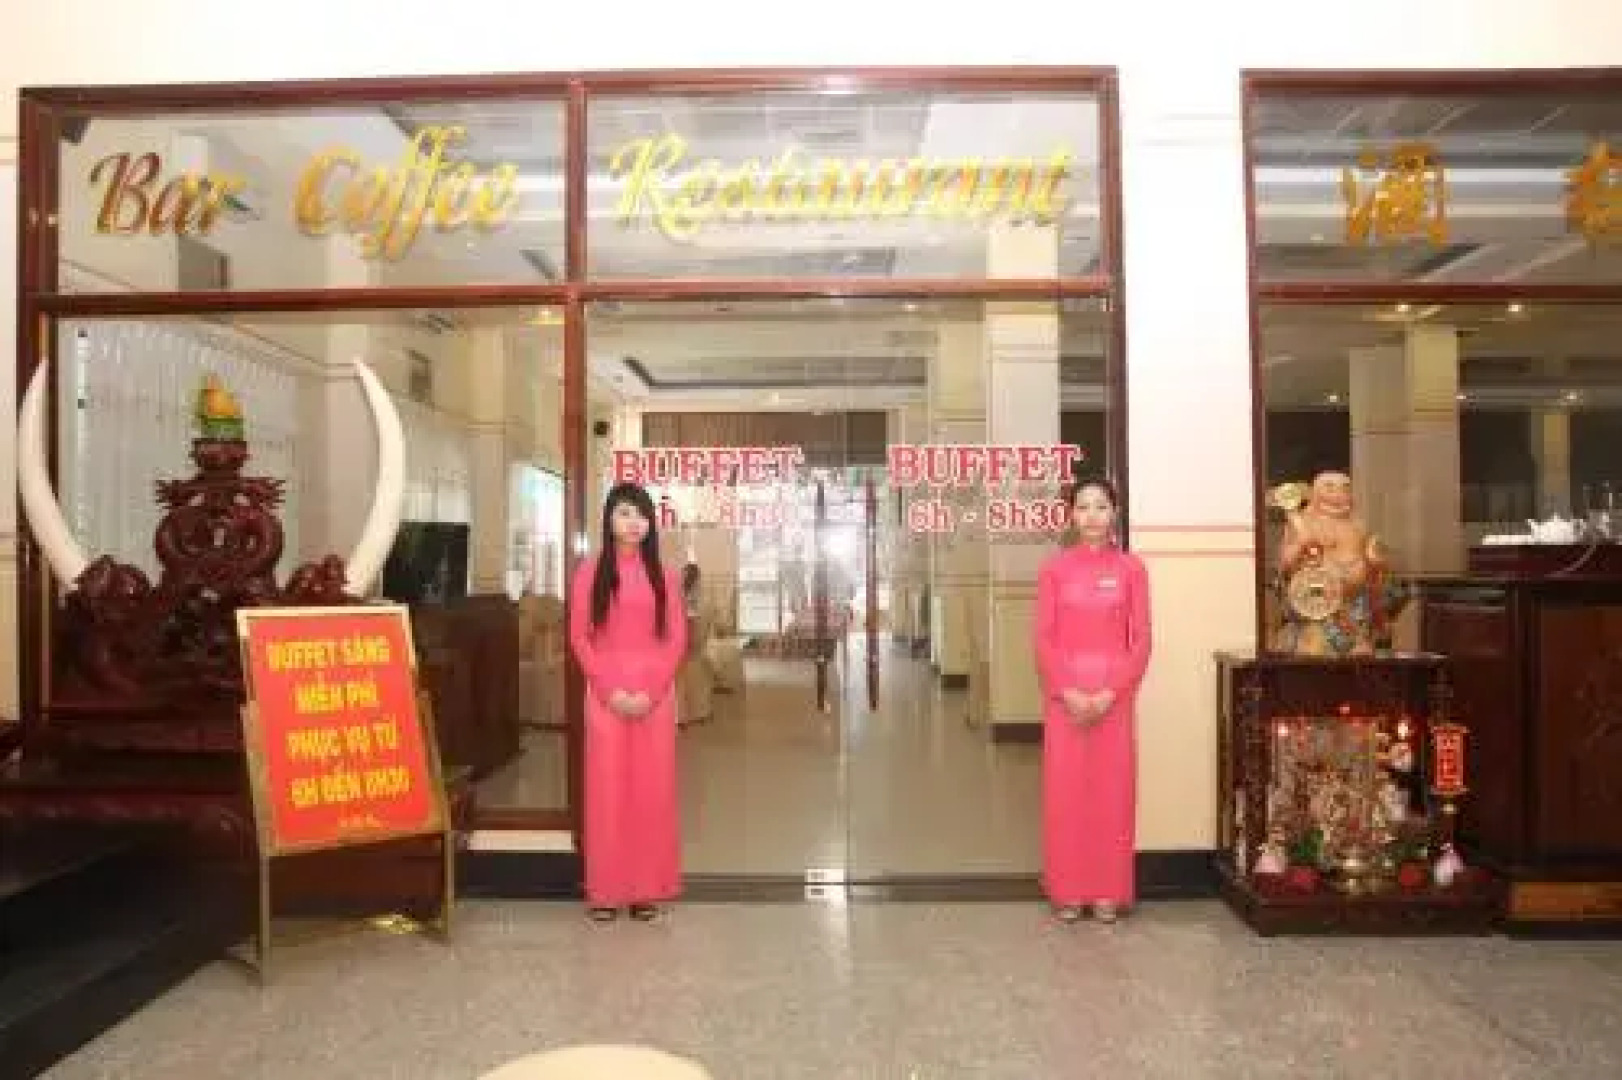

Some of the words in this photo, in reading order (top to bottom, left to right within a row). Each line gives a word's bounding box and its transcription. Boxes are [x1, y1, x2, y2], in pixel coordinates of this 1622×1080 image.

[90, 151, 246, 236] Bar
[293, 125, 519, 262] Coffee
[608, 131, 1075, 243] Restaurant
[612, 444, 804, 486] BUFFET
[888, 442, 1082, 487] BUFFET
[907, 500, 952, 532] 6h
[987, 499, 1070, 532] 8h30
